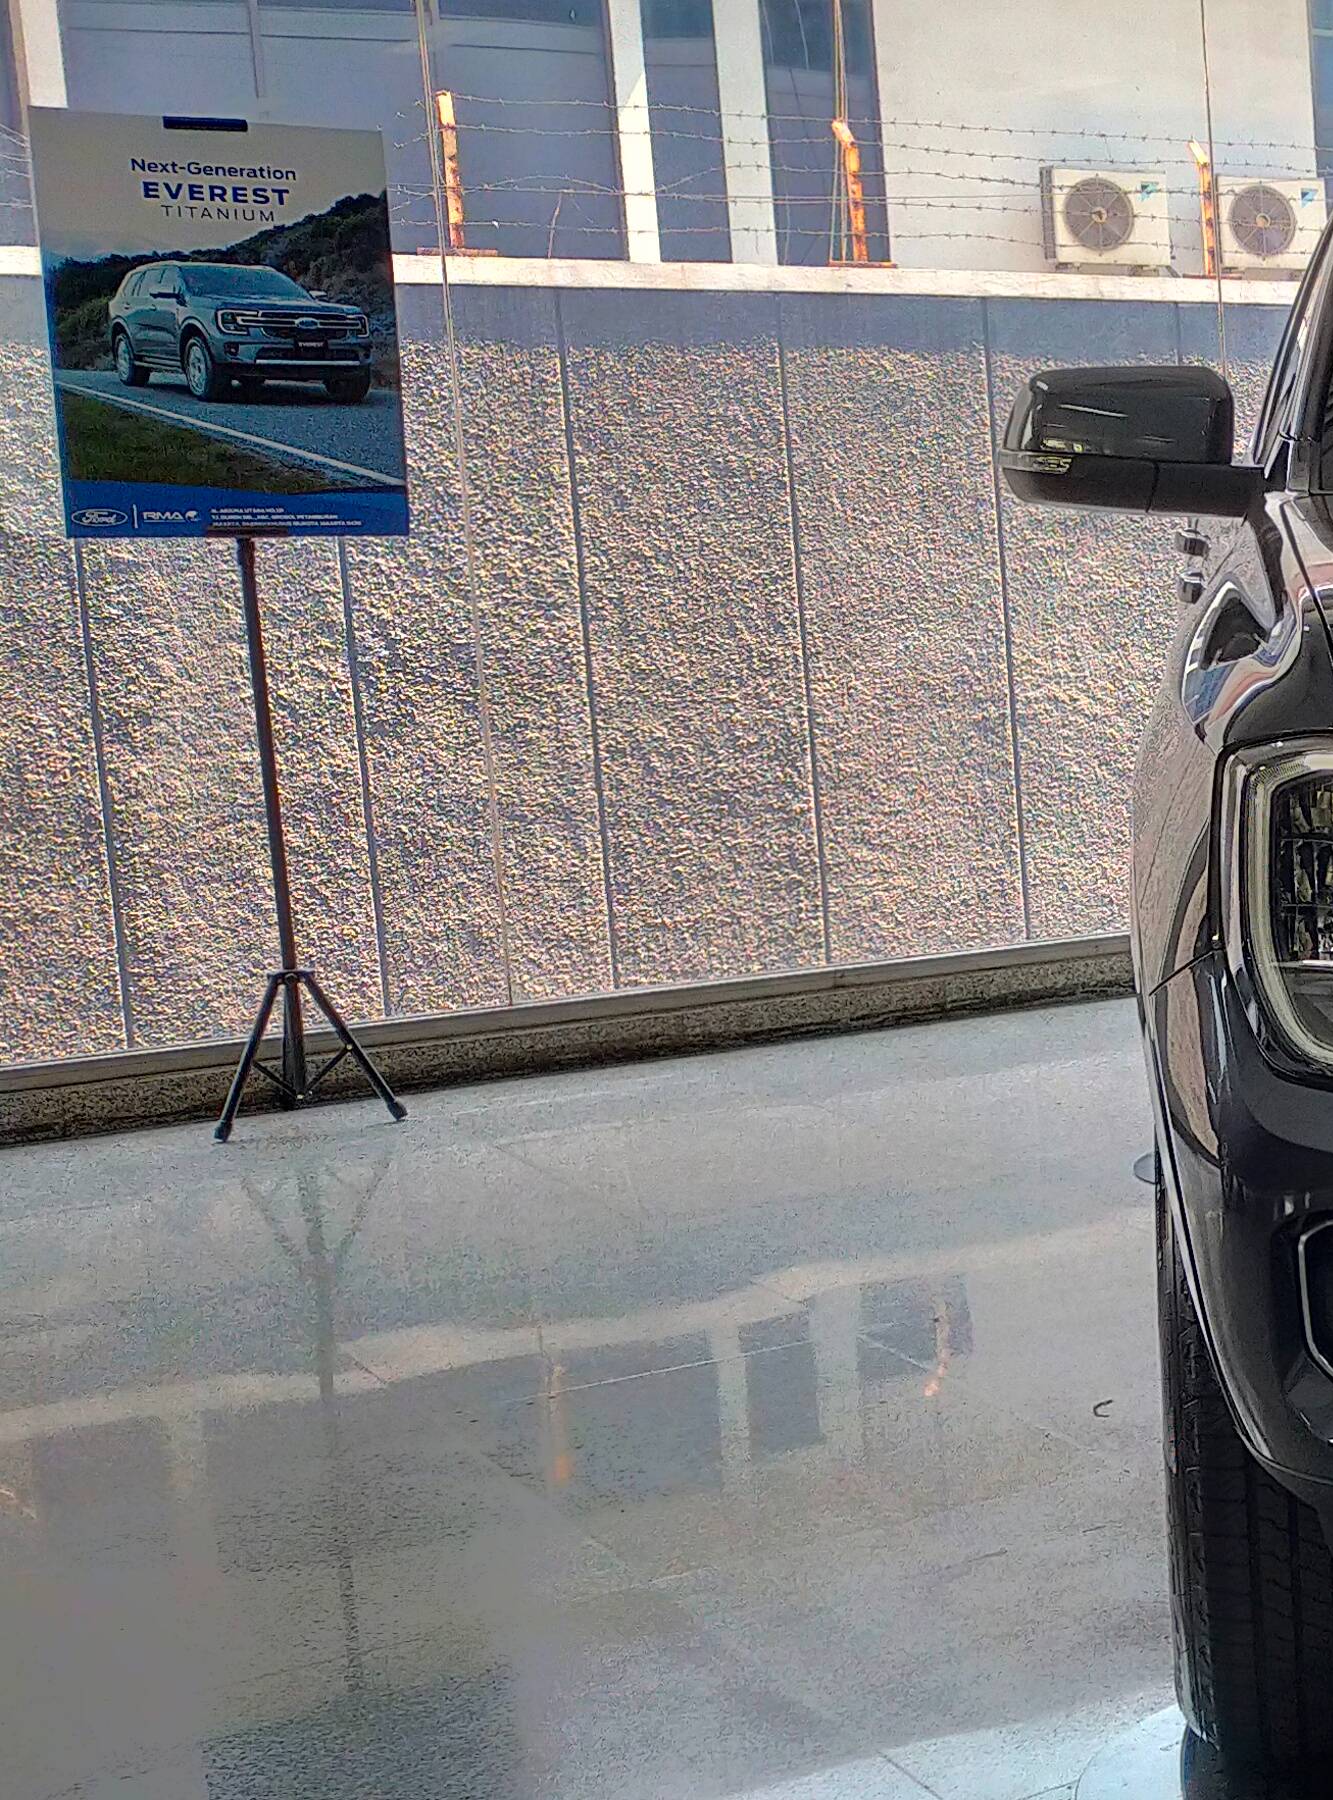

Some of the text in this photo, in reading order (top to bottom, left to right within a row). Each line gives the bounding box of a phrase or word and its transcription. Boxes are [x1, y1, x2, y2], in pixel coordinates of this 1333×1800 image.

[130, 158, 297, 181] Next-Generation
[142, 181, 290, 206] EVEREST
[161, 204, 275, 222] TITANIUM
[81, 511, 184, 523] Ford RMA
